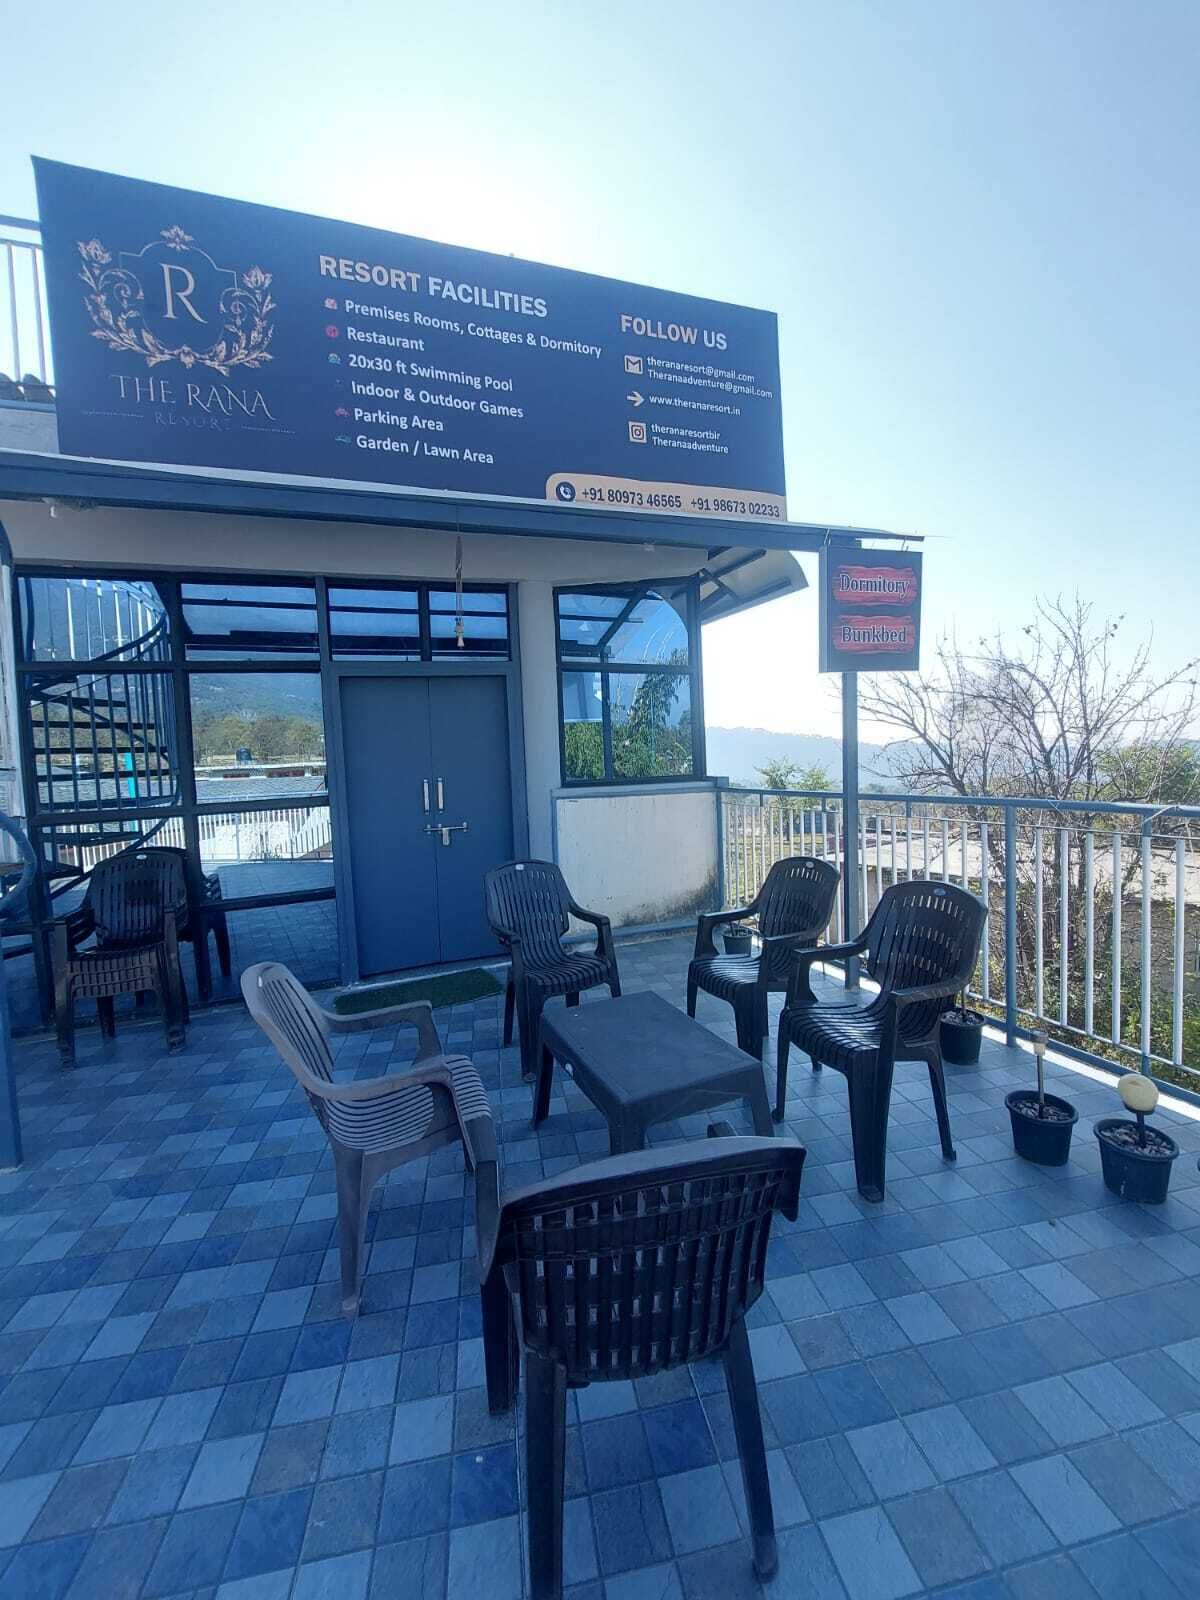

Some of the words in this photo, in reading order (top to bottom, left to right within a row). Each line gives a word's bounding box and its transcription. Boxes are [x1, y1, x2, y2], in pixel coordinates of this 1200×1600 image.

[160, 263, 208, 323] R
[319, 254, 421, 293] RESORT
[428, 275, 548, 318] FACILITIES
[345, 299, 410, 323] Premises
[413, 311, 464, 335] Rooms,
[467, 322, 523, 345] Cottages
[526, 332, 537, 346] &
[540, 335, 602, 359] Dormitory
[347, 326, 425, 352] Restaurant
[620, 314, 698, 345] FOLLOW
[703, 329, 728, 351] US
[348, 353, 392, 372] 20x30
[395, 360, 407, 375] ft
[410, 363, 481, 389] Swimming
[485, 376, 513, 392] Pool
[646, 356, 755, 383] theranaresort@gmail.com
[111, 374, 176, 404] THE
[186, 383, 277, 421] RANA
[647, 369, 773, 399] Theranaadventure@gmail.com
[351, 380, 400, 400] Indoor
[403, 387, 416, 402] &
[419, 390, 476, 412] Outdoor
[479, 401, 524, 419] Games
[649, 395, 741, 416] www.theranaresort.in
[353, 408, 408, 429] Parking
[411, 415, 444, 432] Area
[651, 423, 721, 440] theranaresortbir
[356, 435, 409, 454] Garden
[413, 440, 420, 456] /
[424, 443, 459, 460] Lawn
[463, 449, 494, 464] Area
[652, 436, 729, 454] Theranaadventure
[582, 487, 605, 502] +91
[607, 488, 644, 506] 80973
[646, 494, 682, 509] 46565
[690, 498, 712, 512] +91
[713, 499, 747, 514] 98673
[748, 502, 780, 519] 02233
[839, 574, 910, 598] Dormitory
[841, 625, 906, 643] Bunkbed
